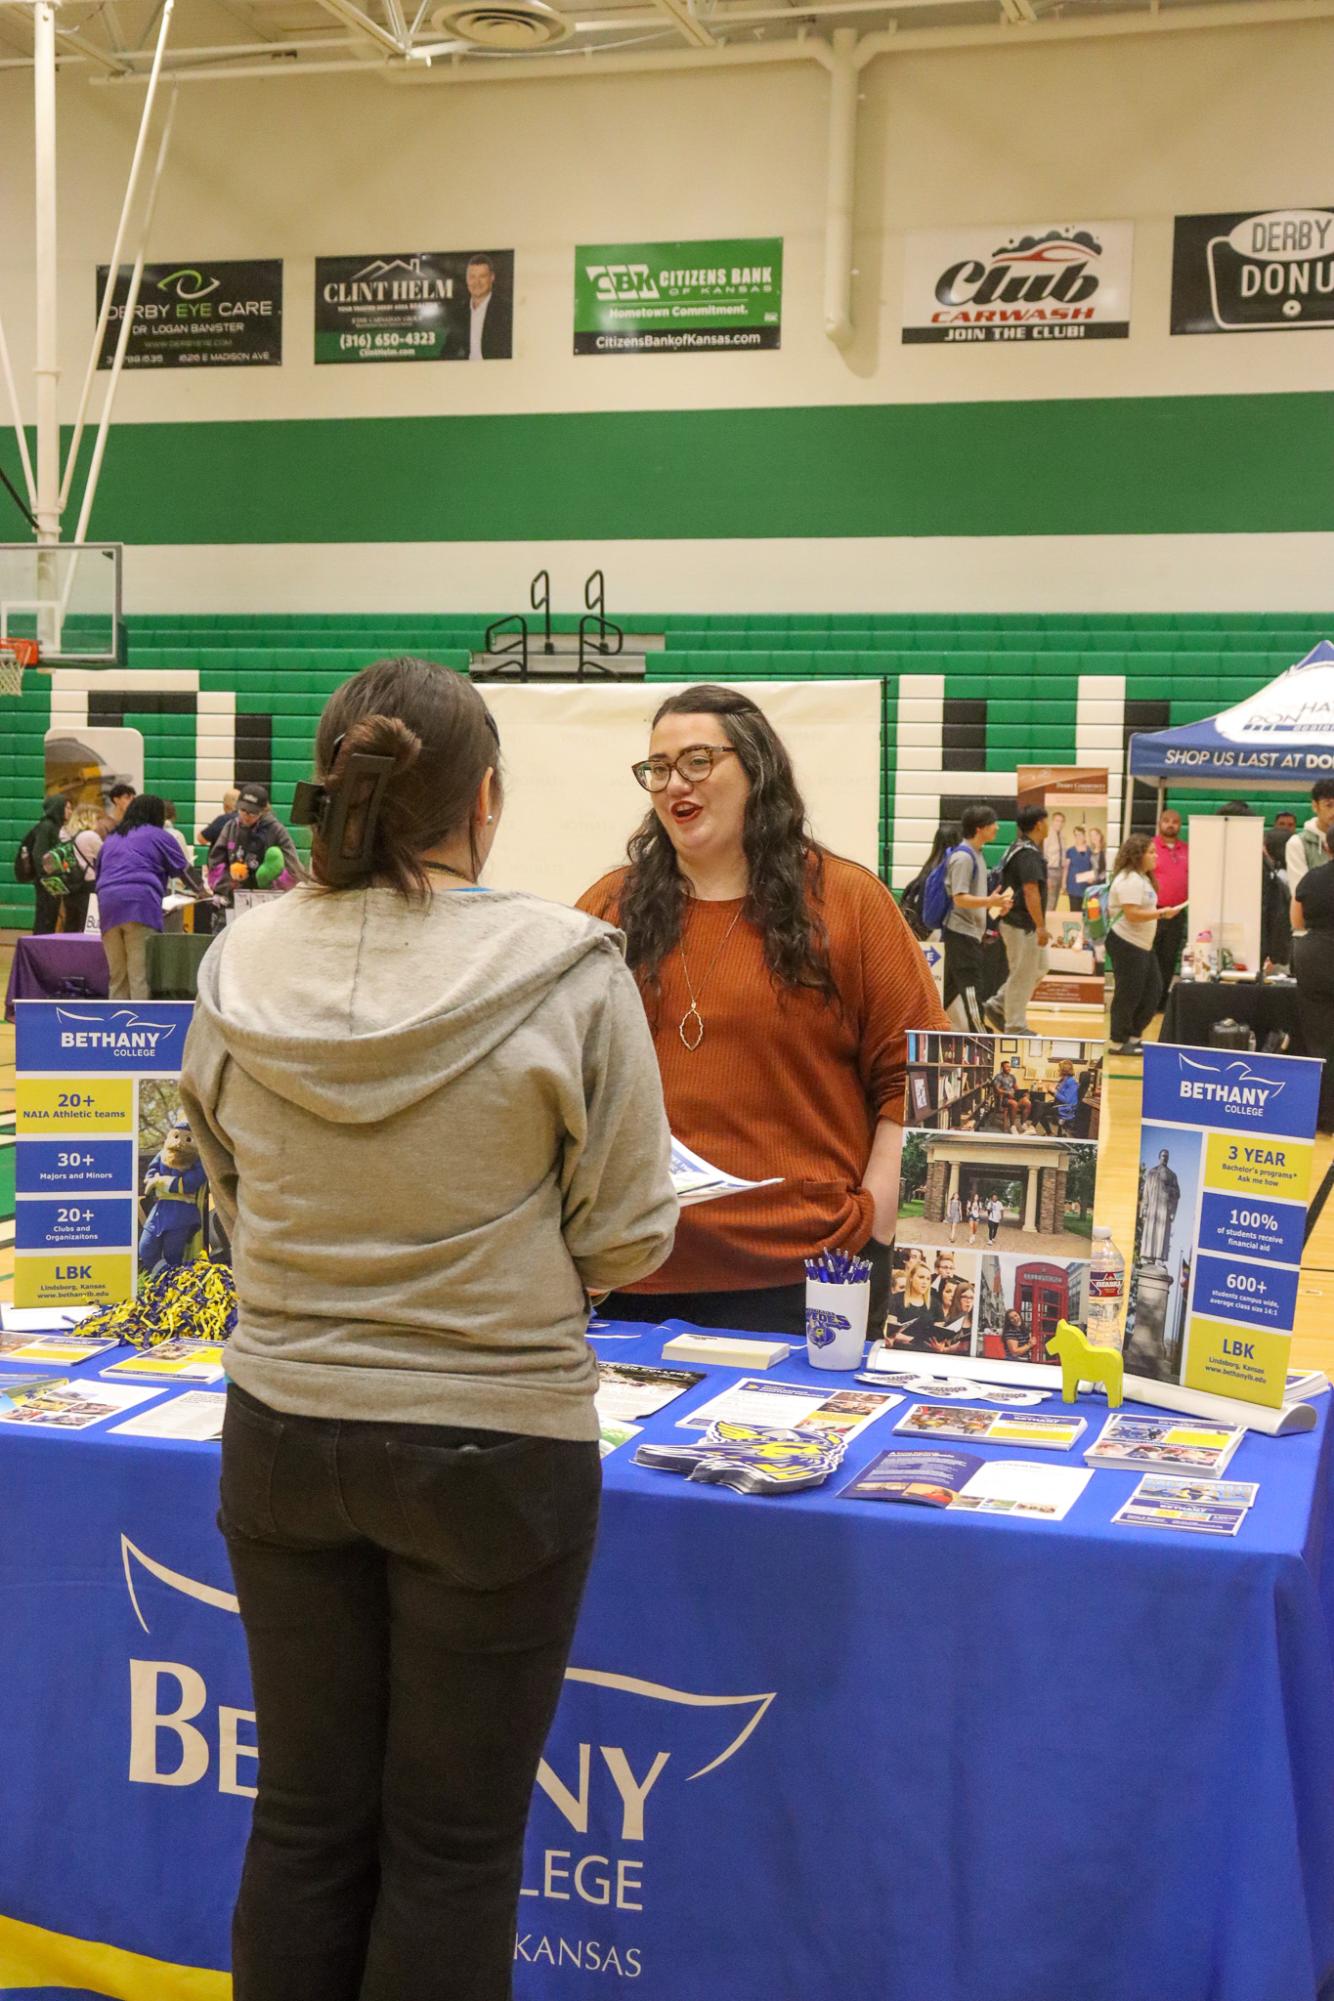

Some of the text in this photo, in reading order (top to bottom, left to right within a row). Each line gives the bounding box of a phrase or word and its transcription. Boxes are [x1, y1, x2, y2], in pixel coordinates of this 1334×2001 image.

[1251, 218, 1332, 254] DERBY
[659, 266, 773, 288] CITIZENS BANK
[934, 260, 1100, 307] Club
[1240, 260, 1334, 298] DONU
[323, 278, 454, 304] CLINT HELM
[668, 284, 773, 297] OF KANSAS
[176, 302, 212, 318] EYE
[218, 300, 273, 317] CARE
[609, 303, 749, 320] Hometown Commitment.
[930, 307, 1096, 324] CARWASH
[132, 324, 147, 335] DR
[152, 323, 188, 335] LOGAN
[944, 324, 1085, 342] JOIN THE CLUB!
[339, 331, 436, 350] (316) 650-4323
[595, 332, 761, 350] CitizensBankofKansas.com
[1164, 749, 1334, 769] SHOP US LAST AT DO
[61, 1032, 160, 1048] BETHANY
[113, 1049, 156, 1057] COLLEGE
[58, 1093, 95, 1107] 20+
[1179, 1080, 1270, 1106] BETHANY
[23, 1110, 126, 1118] NAIA Athletic teams
[1224, 1104, 1265, 1117] COLLEGE
[57, 1153, 94, 1167] 30+
[1228, 1145, 1286, 1167] 3 YEAR
[40, 1171, 113, 1181] Majors and Minors
[1237, 1174, 1250, 1183] Ask
[1264, 1178, 1279, 1187] how
[57, 1208, 94, 1222] 20+
[1229, 1209, 1279, 1231] 100%
[1217, 1226, 1284, 1245] of students receive
[1228, 1237, 1271, 1252] financial aid
[55, 1265, 92, 1280] LBK
[1226, 1273, 1267, 1294] 600+
[1239, 1295, 1262, 1304] campus
[1222, 1338, 1255, 1360] LBK
[129, 1657, 671, 1841] BENY
[512, 1931, 642, 1978] KANSAS
